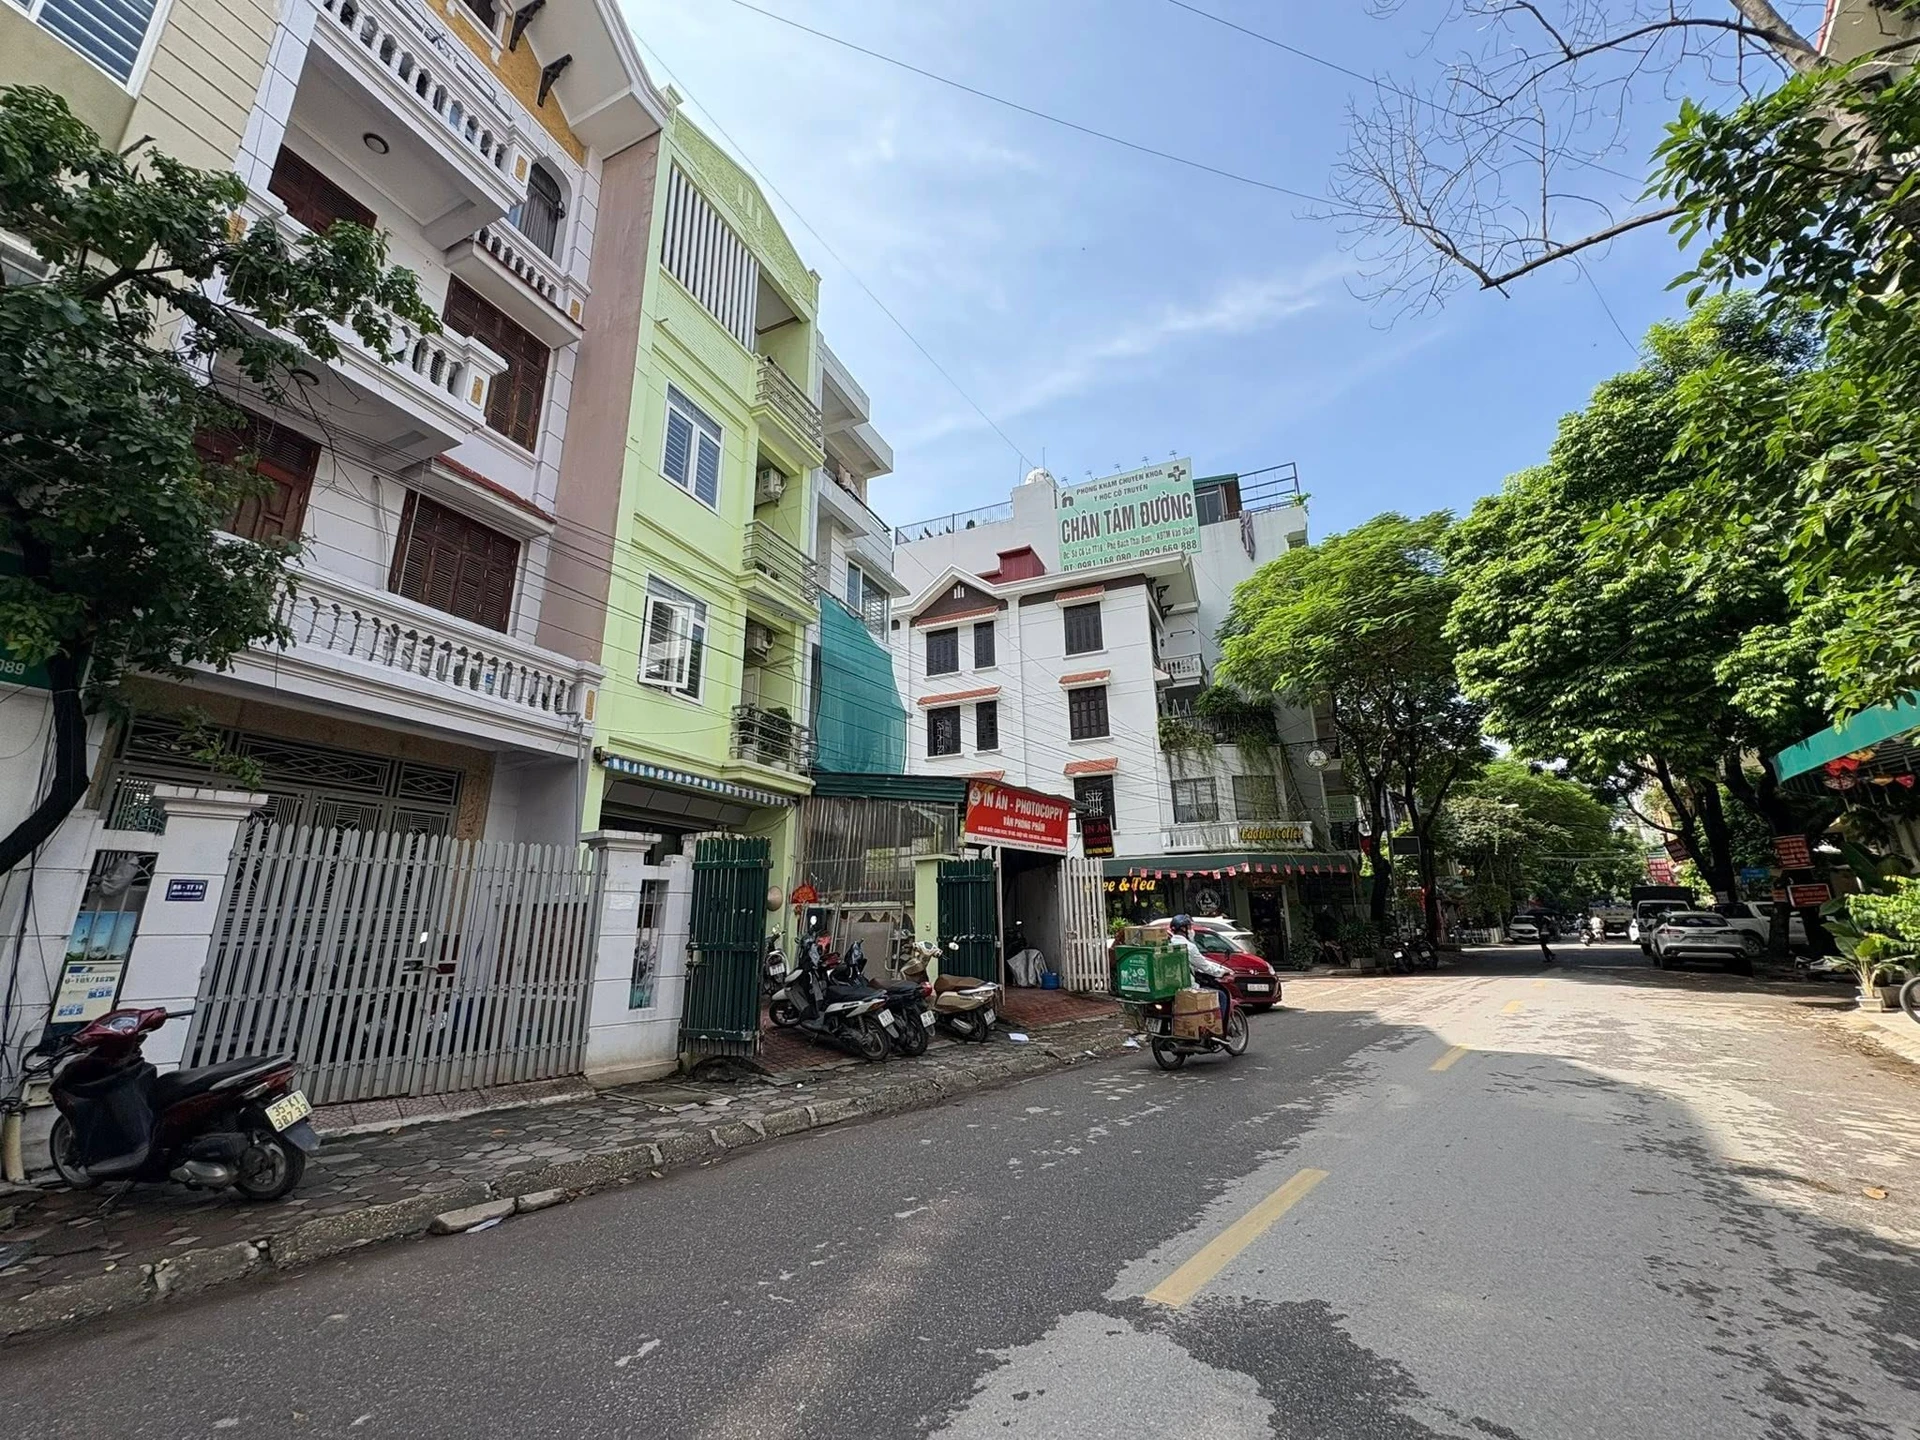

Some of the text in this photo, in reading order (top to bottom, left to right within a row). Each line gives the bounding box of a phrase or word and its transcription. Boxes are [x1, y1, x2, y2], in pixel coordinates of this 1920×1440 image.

[1061, 491, 1193, 544] CHÂN TÂM ĐƯỜNG
[1181, 539, 1197, 551] 888
[983, 792, 994, 808] IN
[1015, 798, 1063, 821] PHOTOCOPPY
[1119, 877, 1130, 892] &
[1131, 877, 1156, 892] Tea
